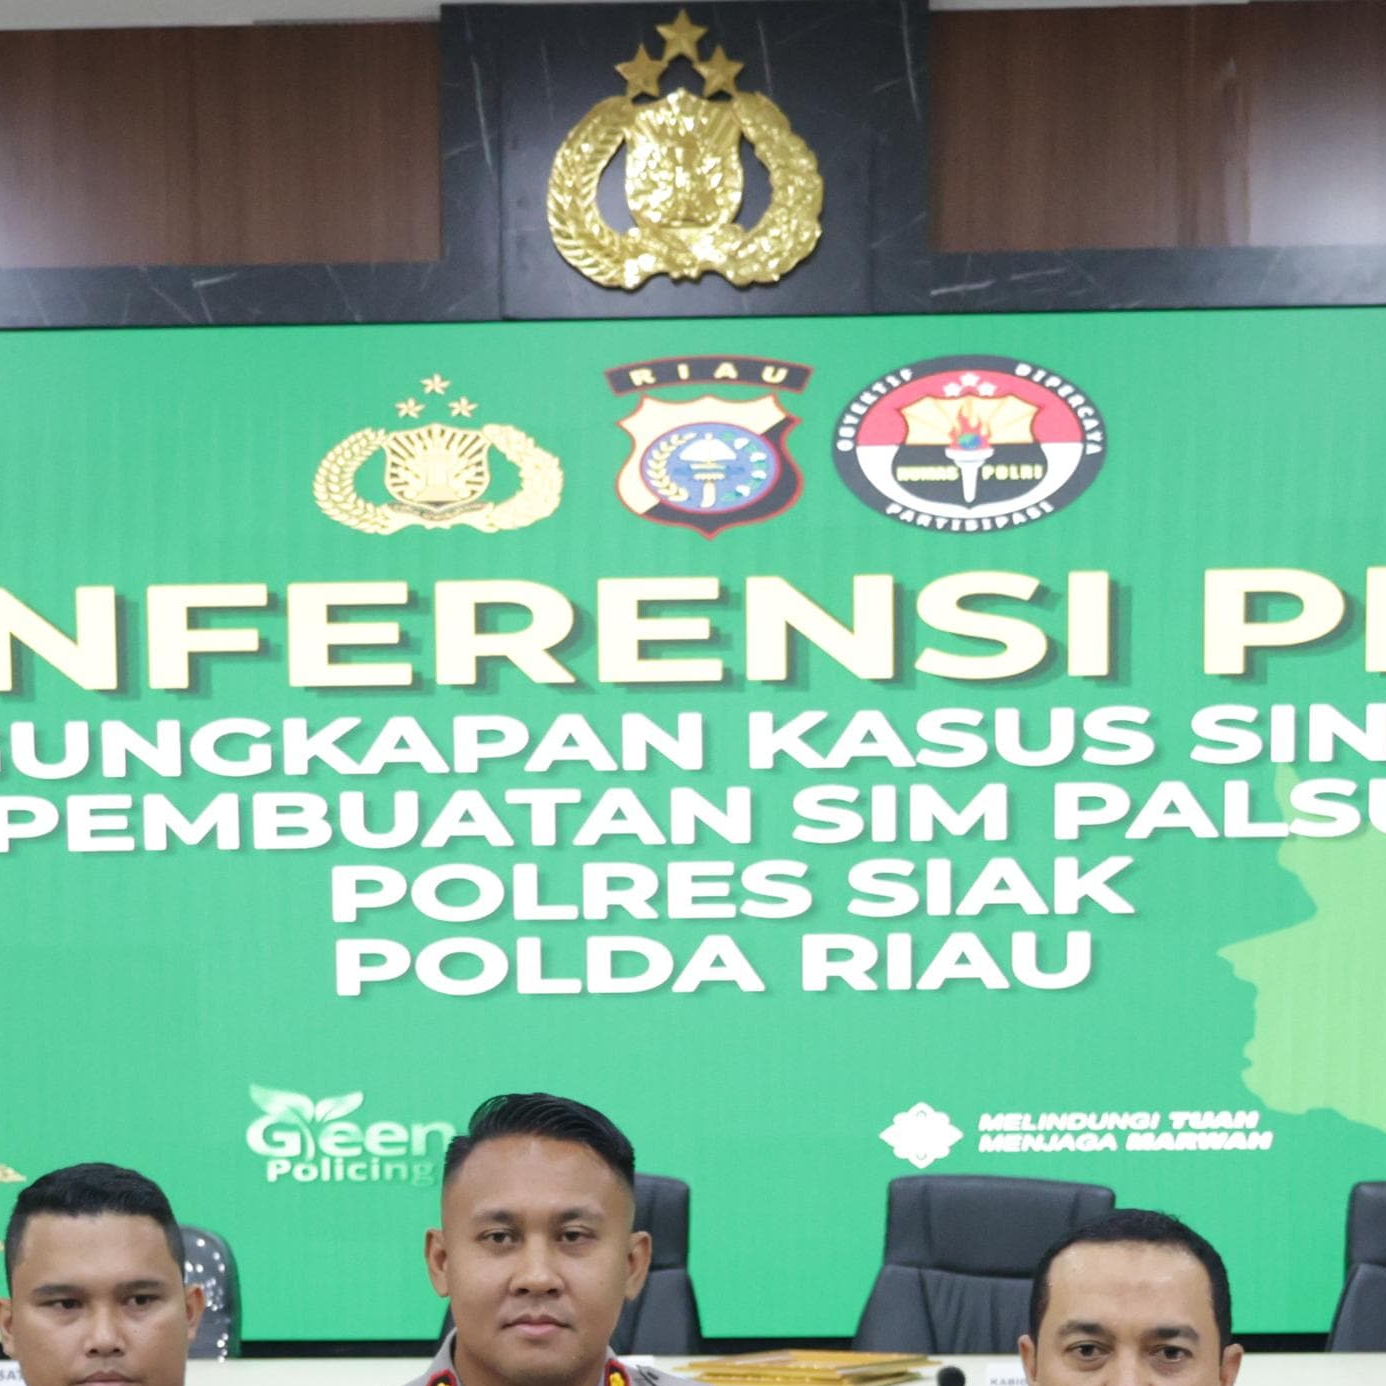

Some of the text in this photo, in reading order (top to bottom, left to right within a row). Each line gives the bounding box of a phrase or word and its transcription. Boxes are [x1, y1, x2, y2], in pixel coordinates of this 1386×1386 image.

[629, 362, 789, 386] RIAU
[981, 465, 1044, 481] POLRI
[885, 500, 1055, 532] PARTISIPASI
[748, 703, 1157, 770] KASUS
[791, 782, 1009, 845] SIM
[330, 854, 1136, 924] POLRES SIAK
[335, 928, 1094, 998] POLDA RIAU
[978, 1111, 1160, 1132] MELINDUNGI
[978, 1133, 1119, 1153] MENJAGA
[267, 1156, 435, 1187] Policing
